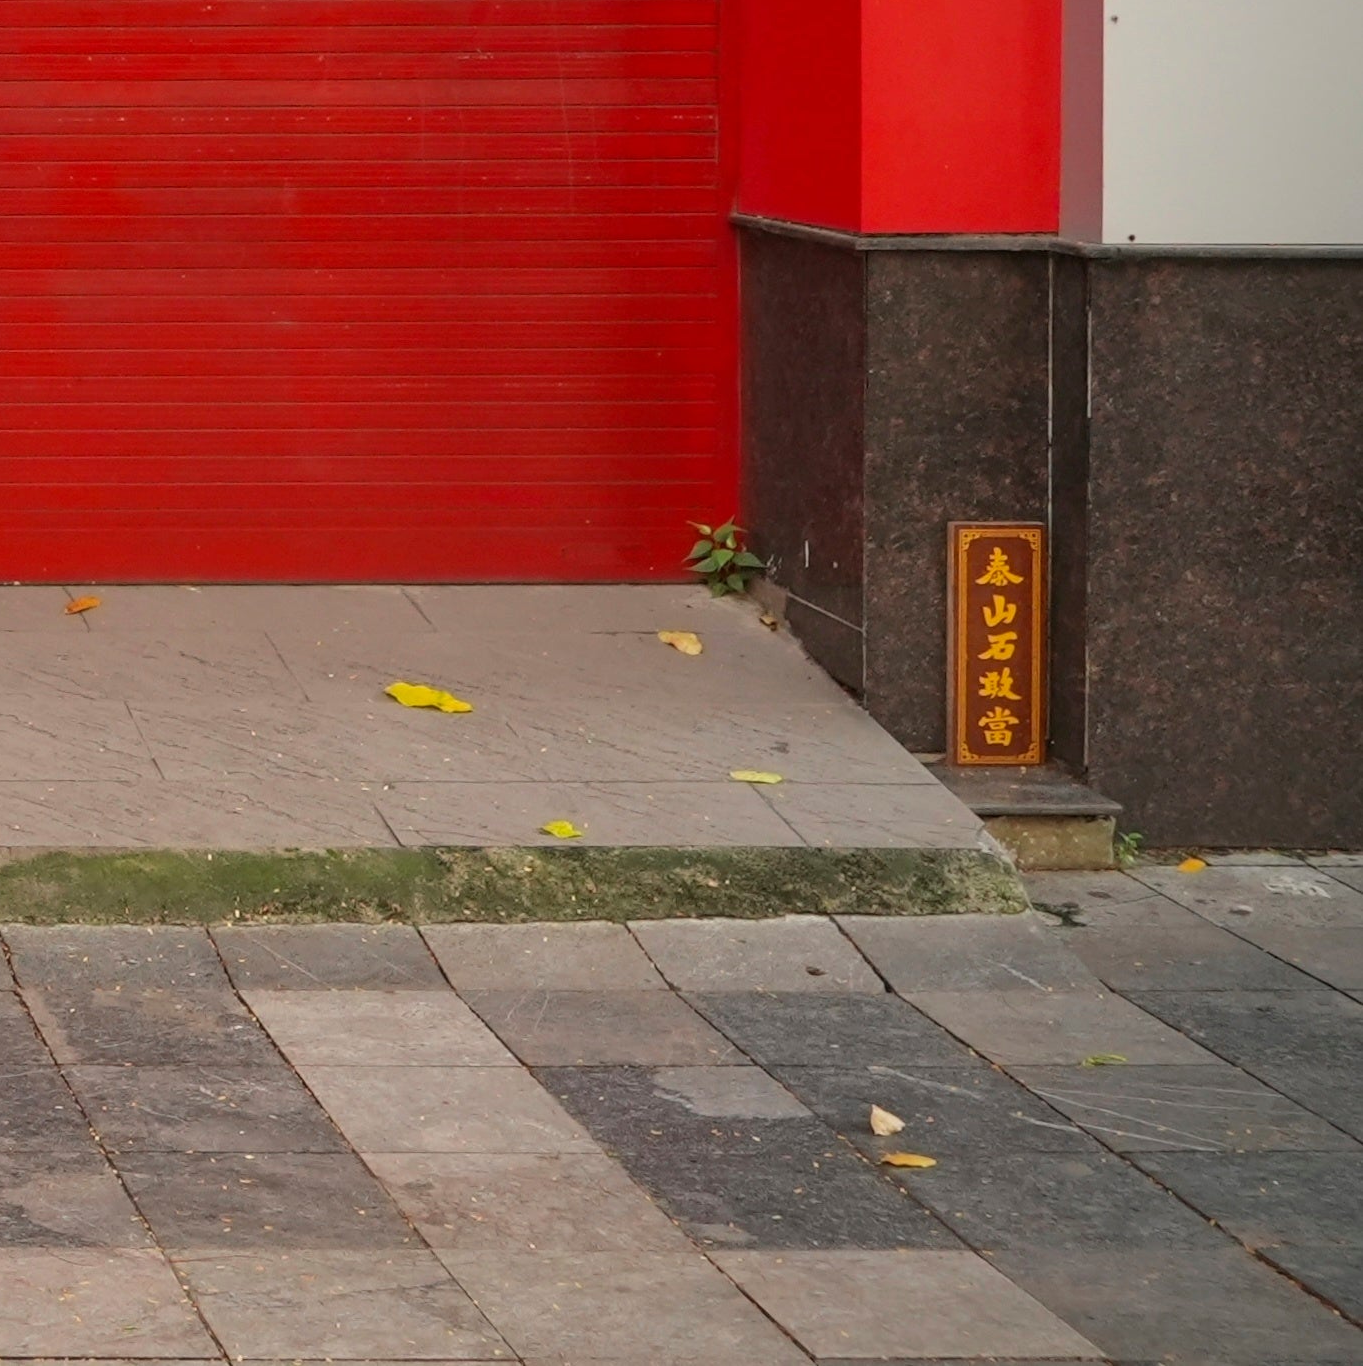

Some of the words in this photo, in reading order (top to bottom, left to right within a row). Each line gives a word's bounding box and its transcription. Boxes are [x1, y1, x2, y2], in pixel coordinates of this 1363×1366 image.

[975, 546, 1024, 746] 泰山石敢當
